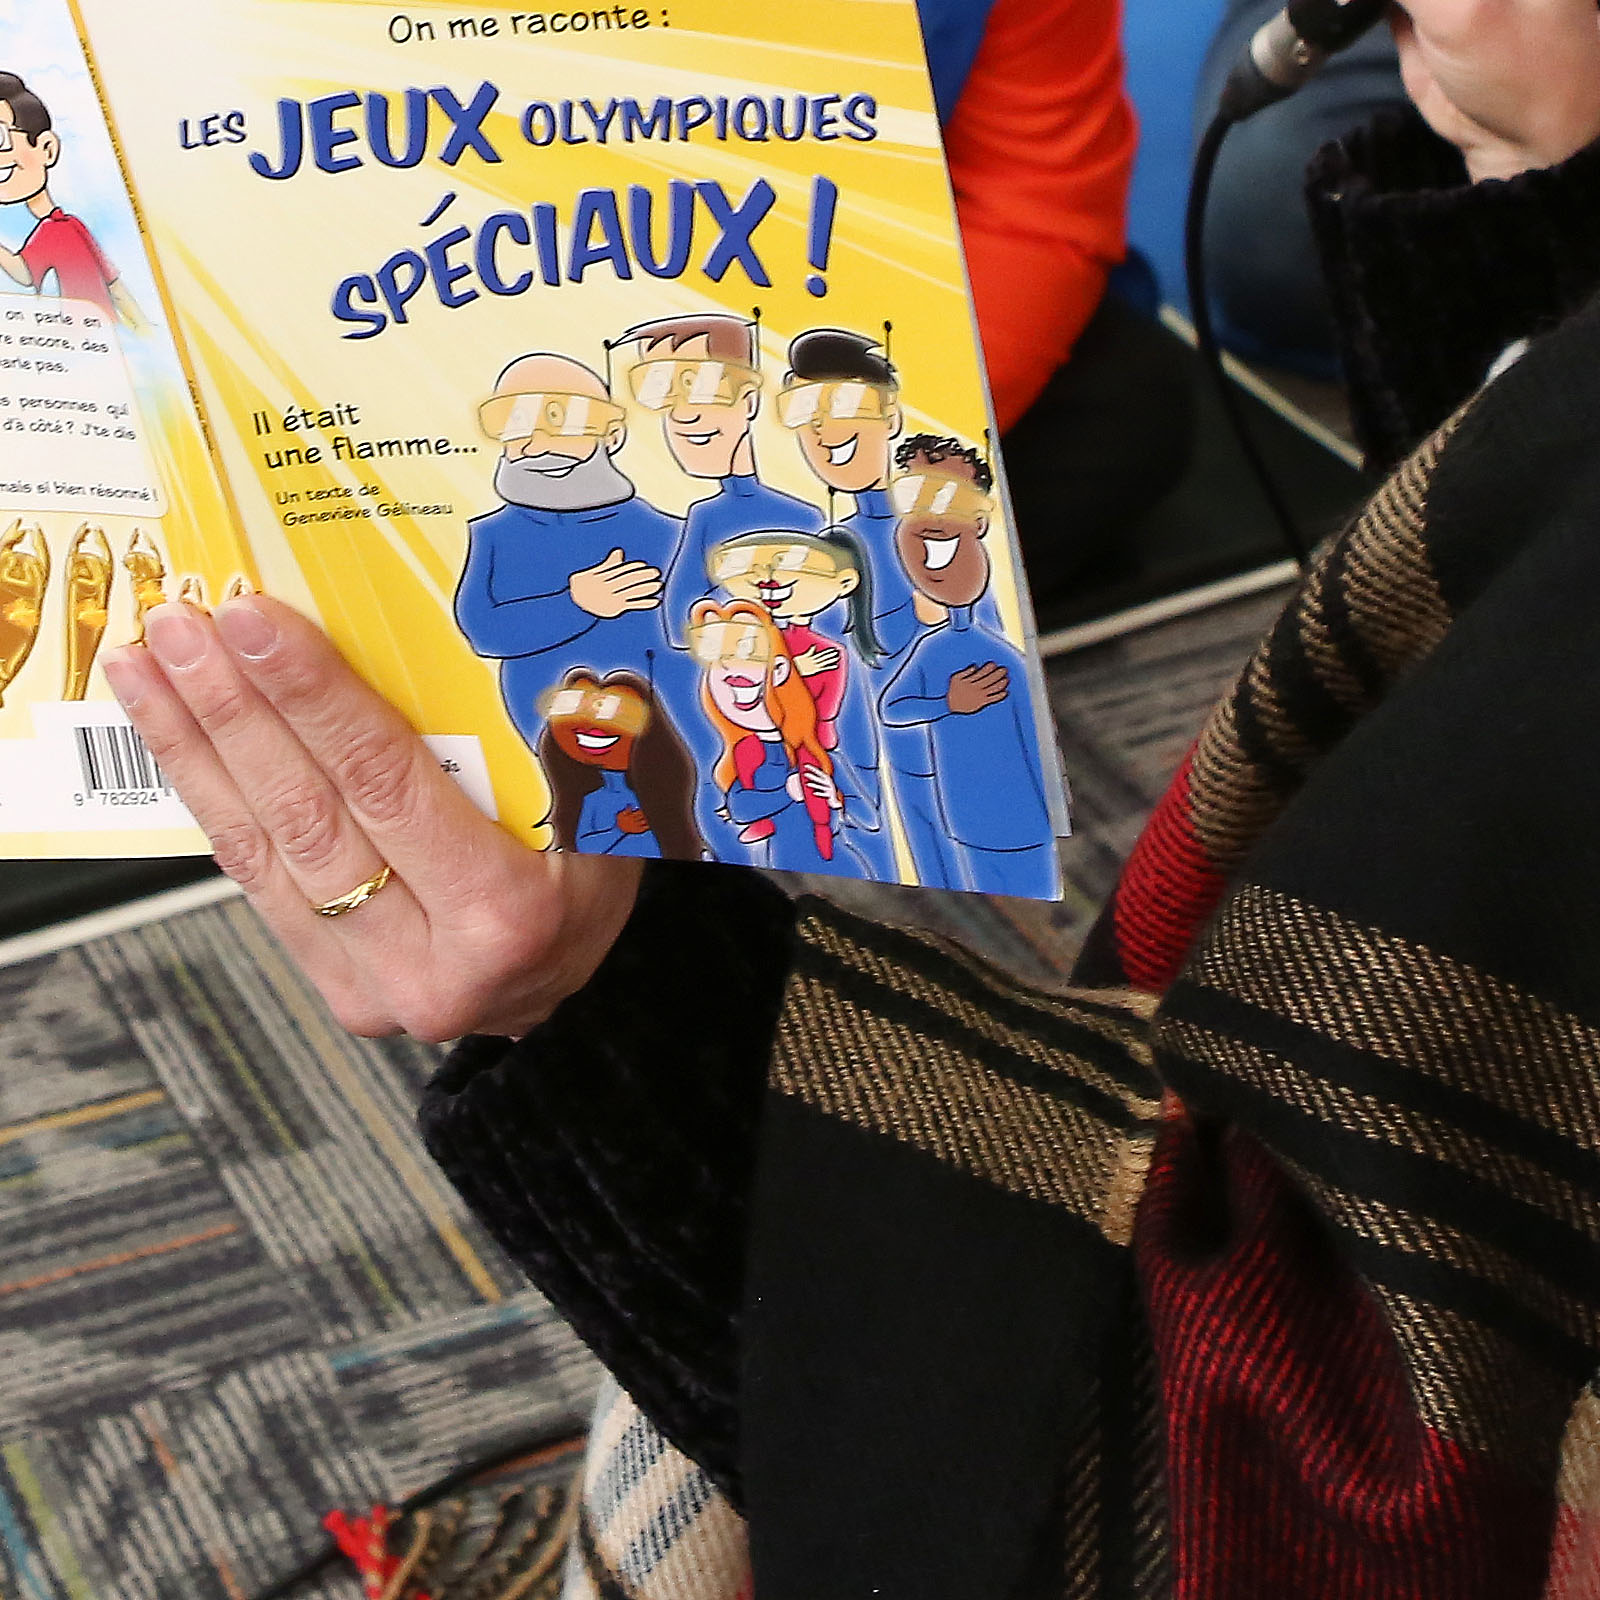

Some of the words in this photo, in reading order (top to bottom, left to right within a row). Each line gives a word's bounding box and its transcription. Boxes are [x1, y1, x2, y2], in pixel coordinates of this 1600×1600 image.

[388, 14, 435, 44] On
[450, 15, 501, 39] me
[511, 4, 651, 35] raconte
[178, 107, 248, 151] LES
[249, 80, 504, 181] JEUX
[520, 92, 879, 148] OLYMPIQUES
[330, 176, 777, 340] SPÉCIAUX
[5, 309, 25, 321] on
[35, 307, 73, 327] parle
[83, 315, 101, 328] en
[81, 338, 110, 354] des
[35, 359, 69, 377] pas.
[19, 395, 98, 414] personnes
[106, 402, 129, 420] qui
[253, 411, 271, 436] Il
[283, 403, 361, 432] était
[114, 426, 137, 441] dis
[264, 447, 323, 469] une
[36, 480, 51, 494] si
[53, 480, 87, 496] bien
[276, 489, 300, 505] Un
[306, 488, 353, 501] texte
[358, 482, 381, 498] de
[283, 506, 371, 526] Geneviève
[376, 501, 454, 519] Gélineau
